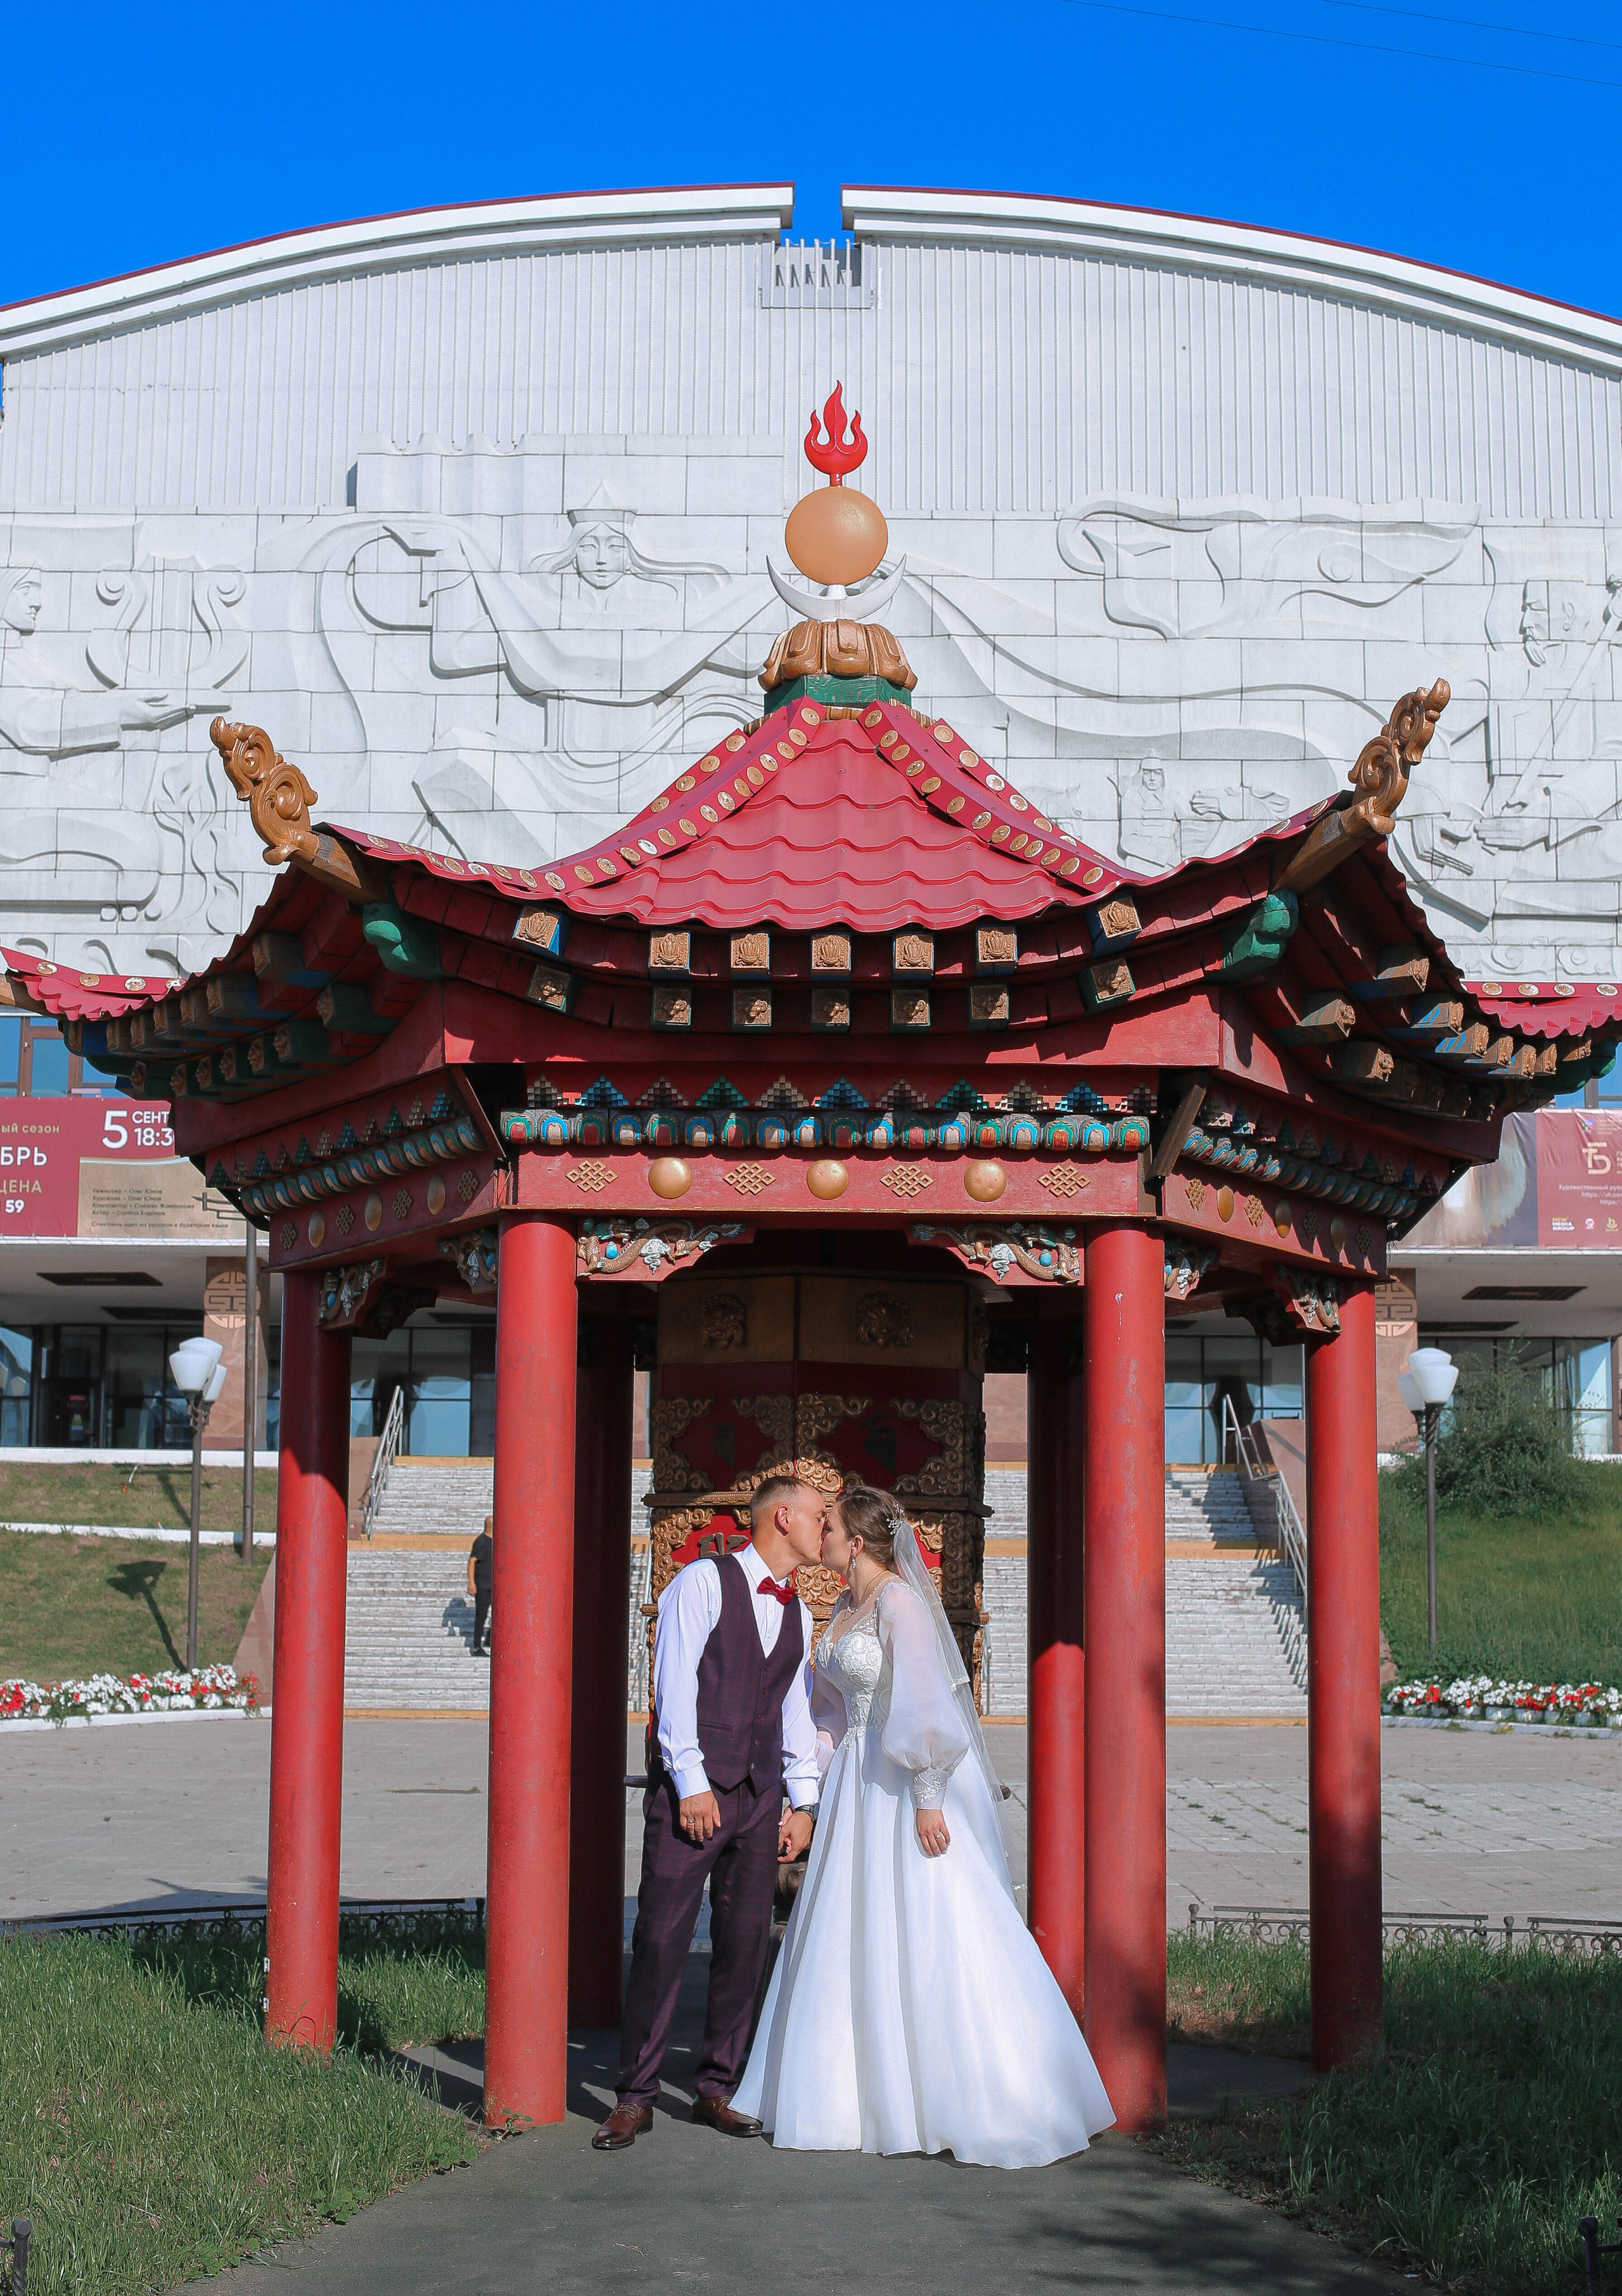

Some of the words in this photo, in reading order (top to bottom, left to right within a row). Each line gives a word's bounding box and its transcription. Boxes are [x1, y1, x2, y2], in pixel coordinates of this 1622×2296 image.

[132, 1110, 170, 1124] СЕНТ
[0, 1123, 18, 1133] ый
[22, 1125, 60, 1133] сезон
[101, 1110, 128, 1150] 5
[134, 1127, 174, 1147] 18:3
[0, 1146, 48, 1166] БРЬ
[4, 1199, 25, 1214] 59
